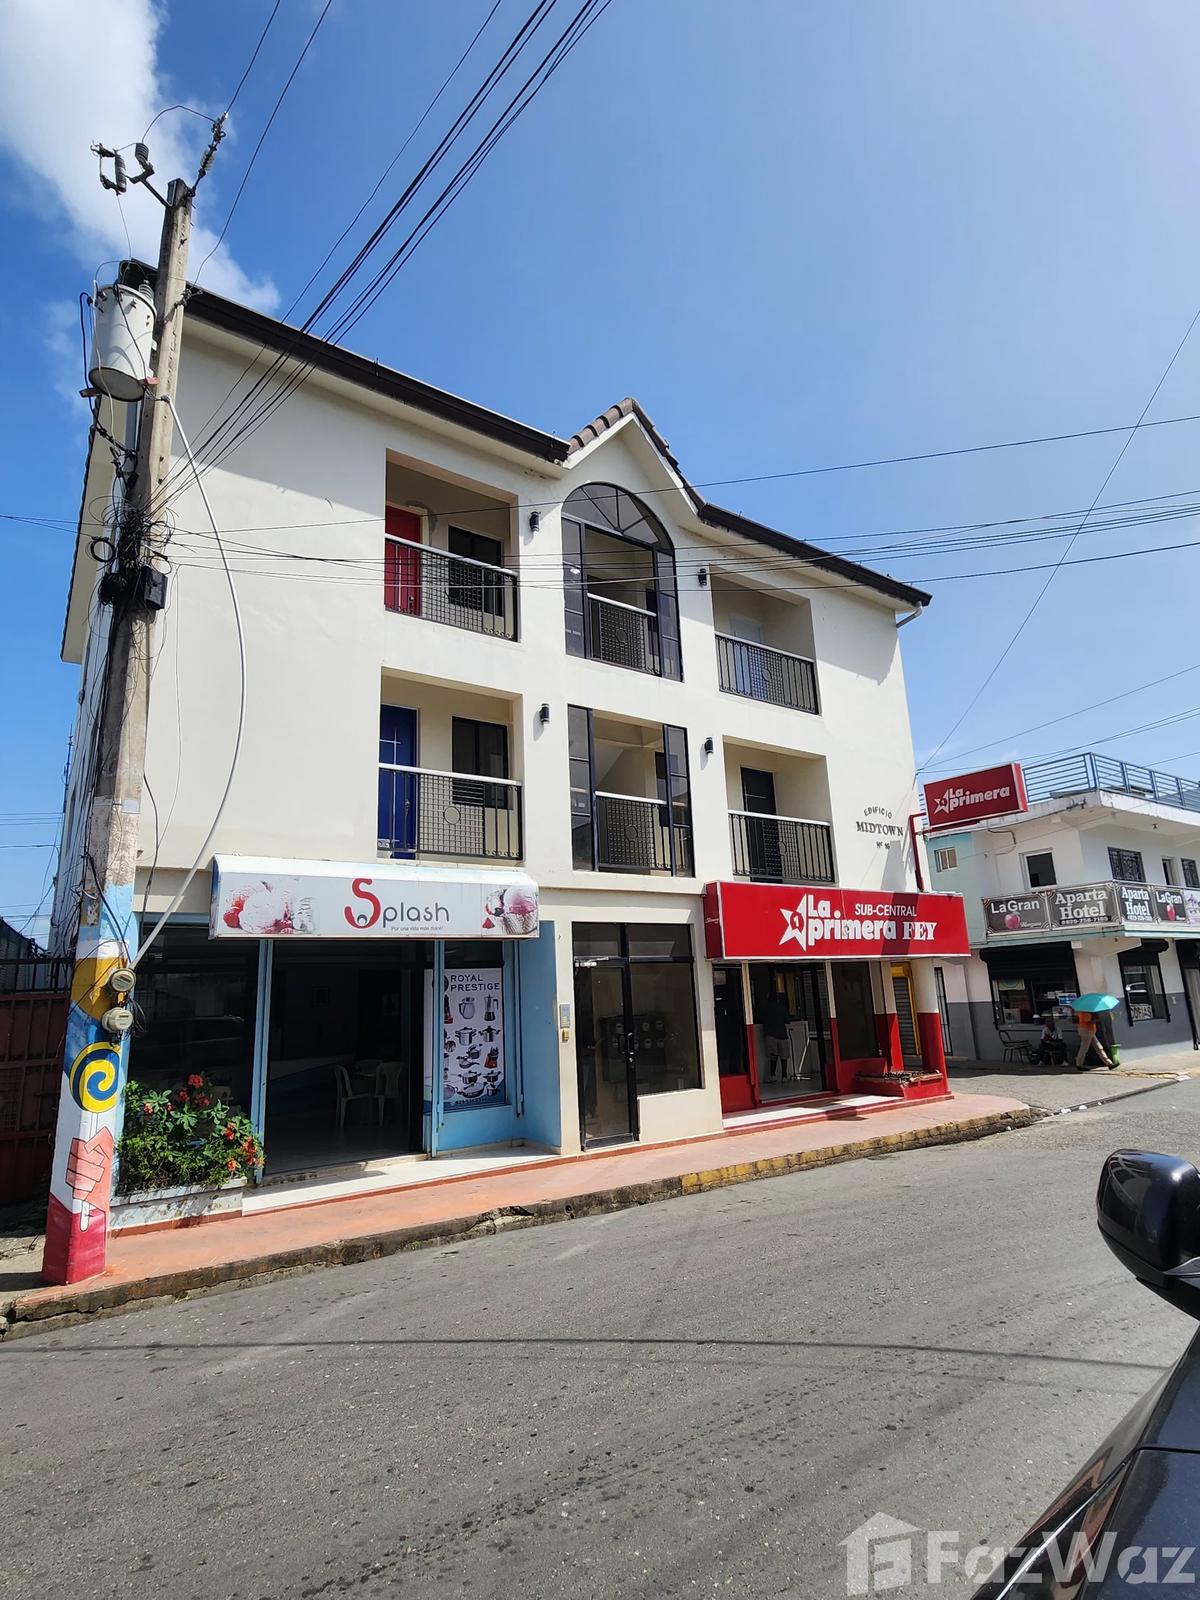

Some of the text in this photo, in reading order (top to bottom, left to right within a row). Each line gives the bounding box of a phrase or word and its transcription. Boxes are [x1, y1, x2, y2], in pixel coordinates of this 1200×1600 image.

[949, 788, 964, 799] La
[950, 786, 1010, 812] primera
[864, 806, 893, 819] EDIFICIO
[856, 821, 904, 837] MIDTOWN
[1055, 889, 1108, 906] Aparta
[1122, 886, 1150, 901] Aparta
[344, 878, 450, 929] Splash
[807, 894, 831, 918] La
[855, 903, 917, 917] SUB-CENTRAL
[1059, 901, 1106, 920] Hotel
[1125, 901, 1151, 916] Hotel
[807, 910, 897, 946] primera
[902, 921, 938, 941] FEY
[451, 974, 483, 982] ROYAL
[450, 983, 500, 992] PRESTIGE
